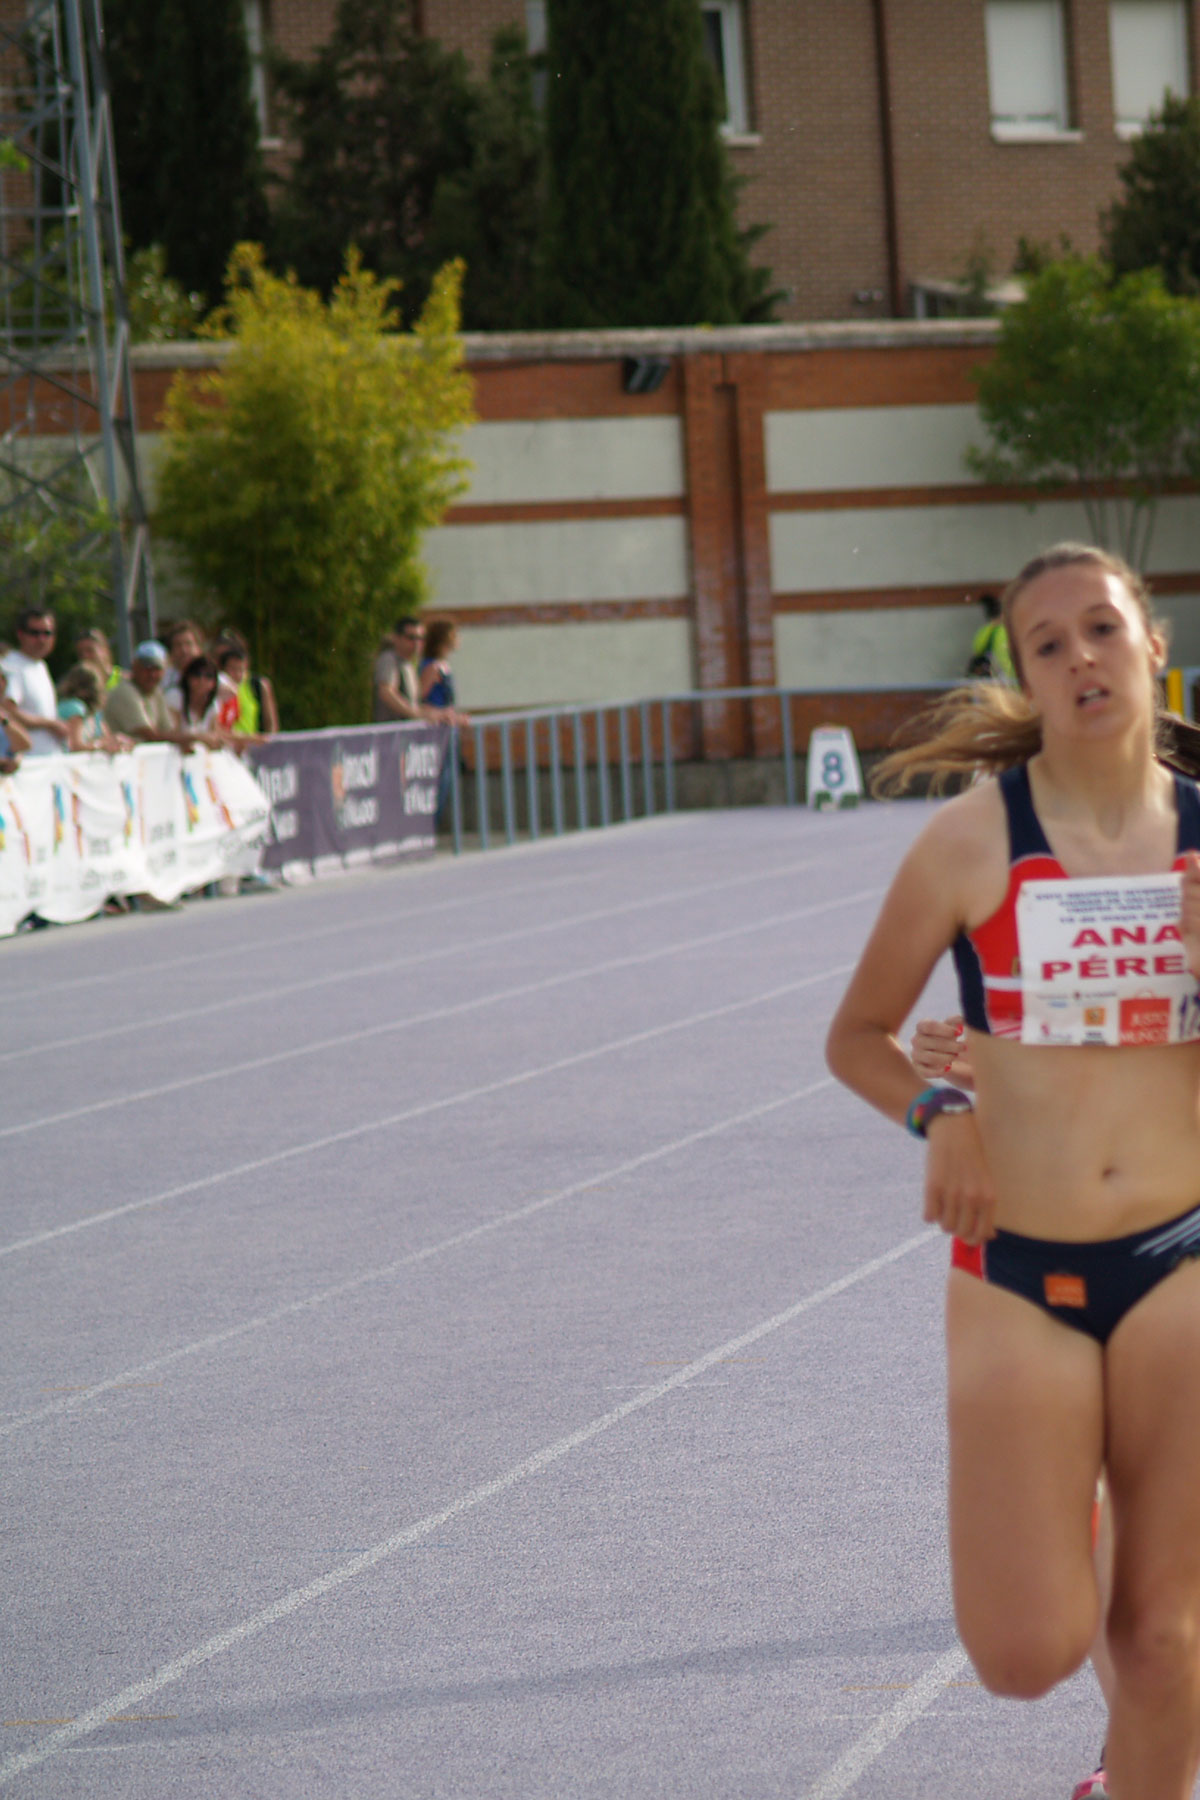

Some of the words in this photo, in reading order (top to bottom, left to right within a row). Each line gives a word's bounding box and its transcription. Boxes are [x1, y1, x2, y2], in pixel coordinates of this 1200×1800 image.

[822, 751, 846, 788] 8
[1072, 924, 1183, 948] ANA
[1042, 953, 1190, 981] PÉRE
